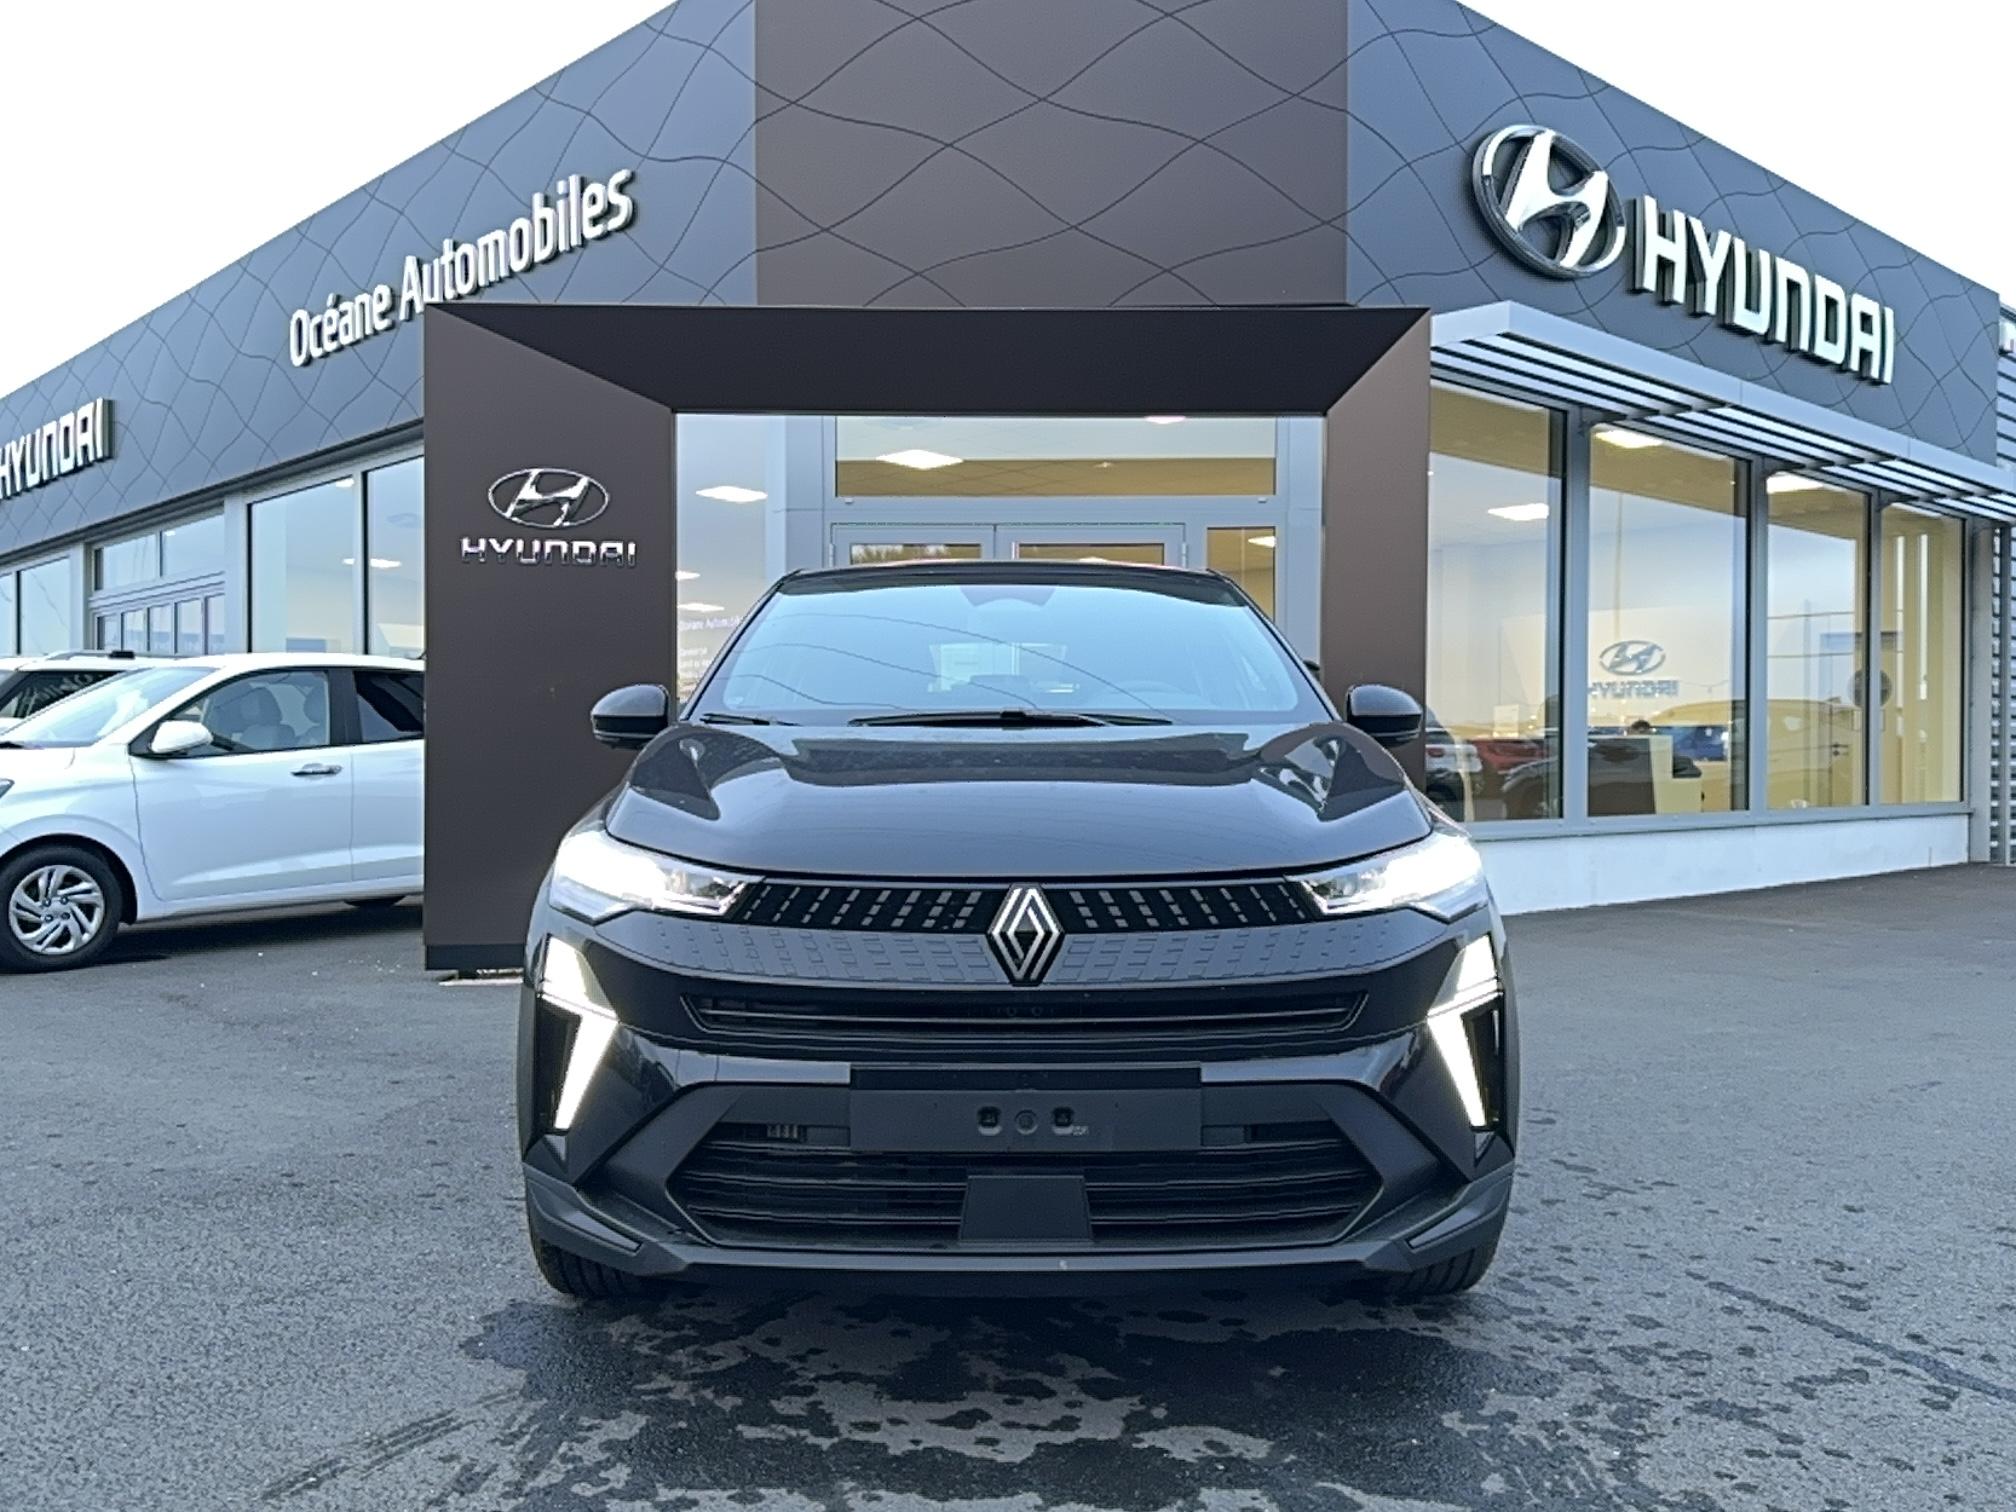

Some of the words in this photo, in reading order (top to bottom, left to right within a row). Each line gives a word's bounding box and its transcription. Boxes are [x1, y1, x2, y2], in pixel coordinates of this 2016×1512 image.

[289, 291, 392, 367] Océane
[399, 169, 635, 321] Automobiles
[1640, 194, 1895, 385] HYUNDAI
[461, 537, 637, 566] HYUNDAI
